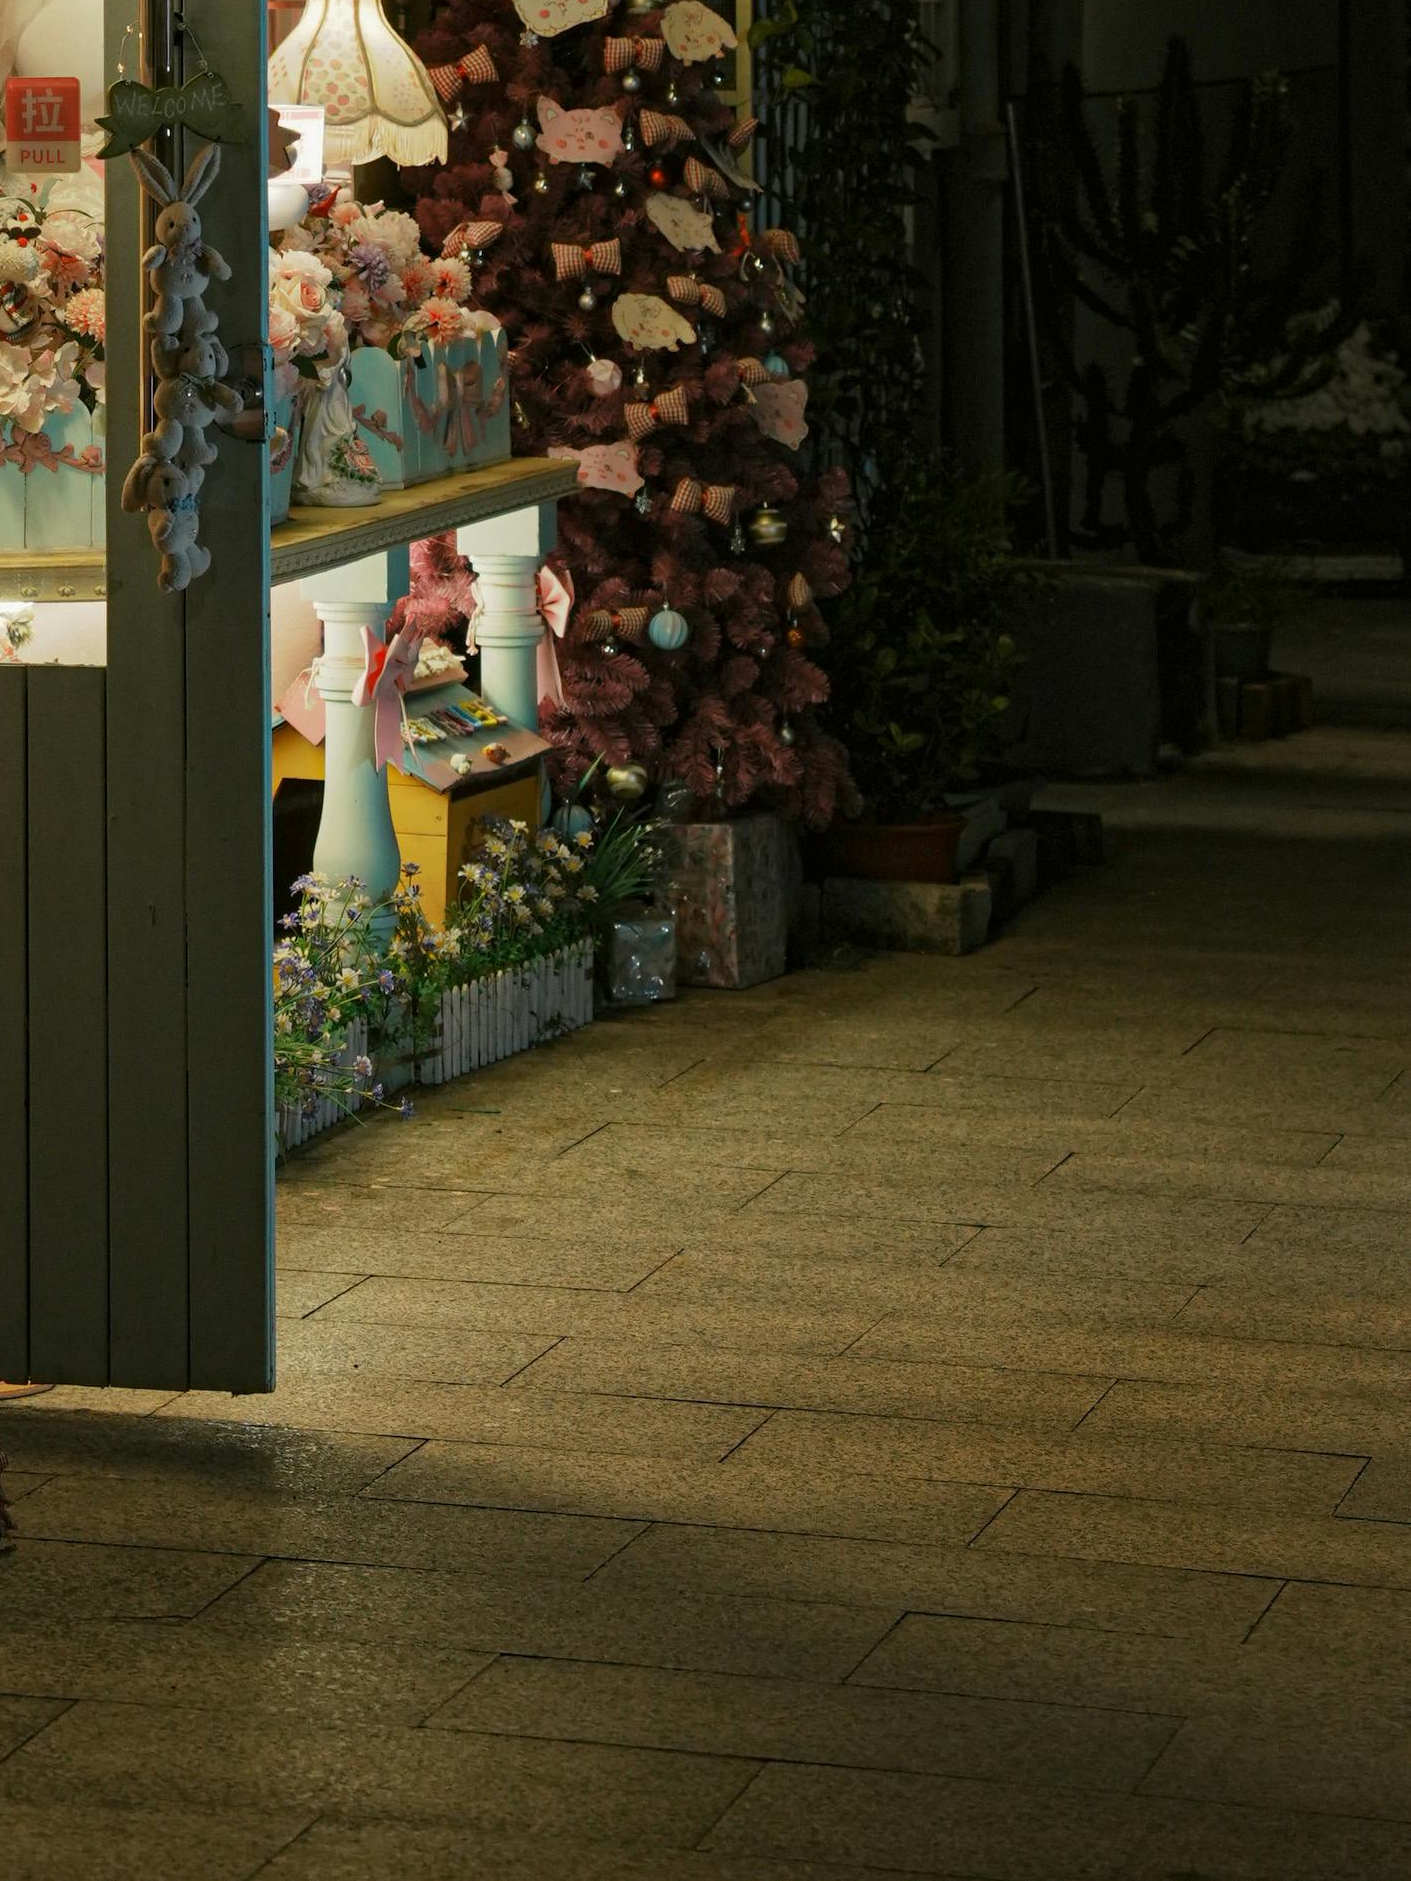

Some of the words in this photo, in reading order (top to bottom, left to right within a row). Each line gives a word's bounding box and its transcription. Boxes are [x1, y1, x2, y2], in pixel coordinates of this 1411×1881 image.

[21, 87, 65, 135] 拉
[115, 83, 225, 118] WELCOME
[20, 149, 66, 165] PULL
